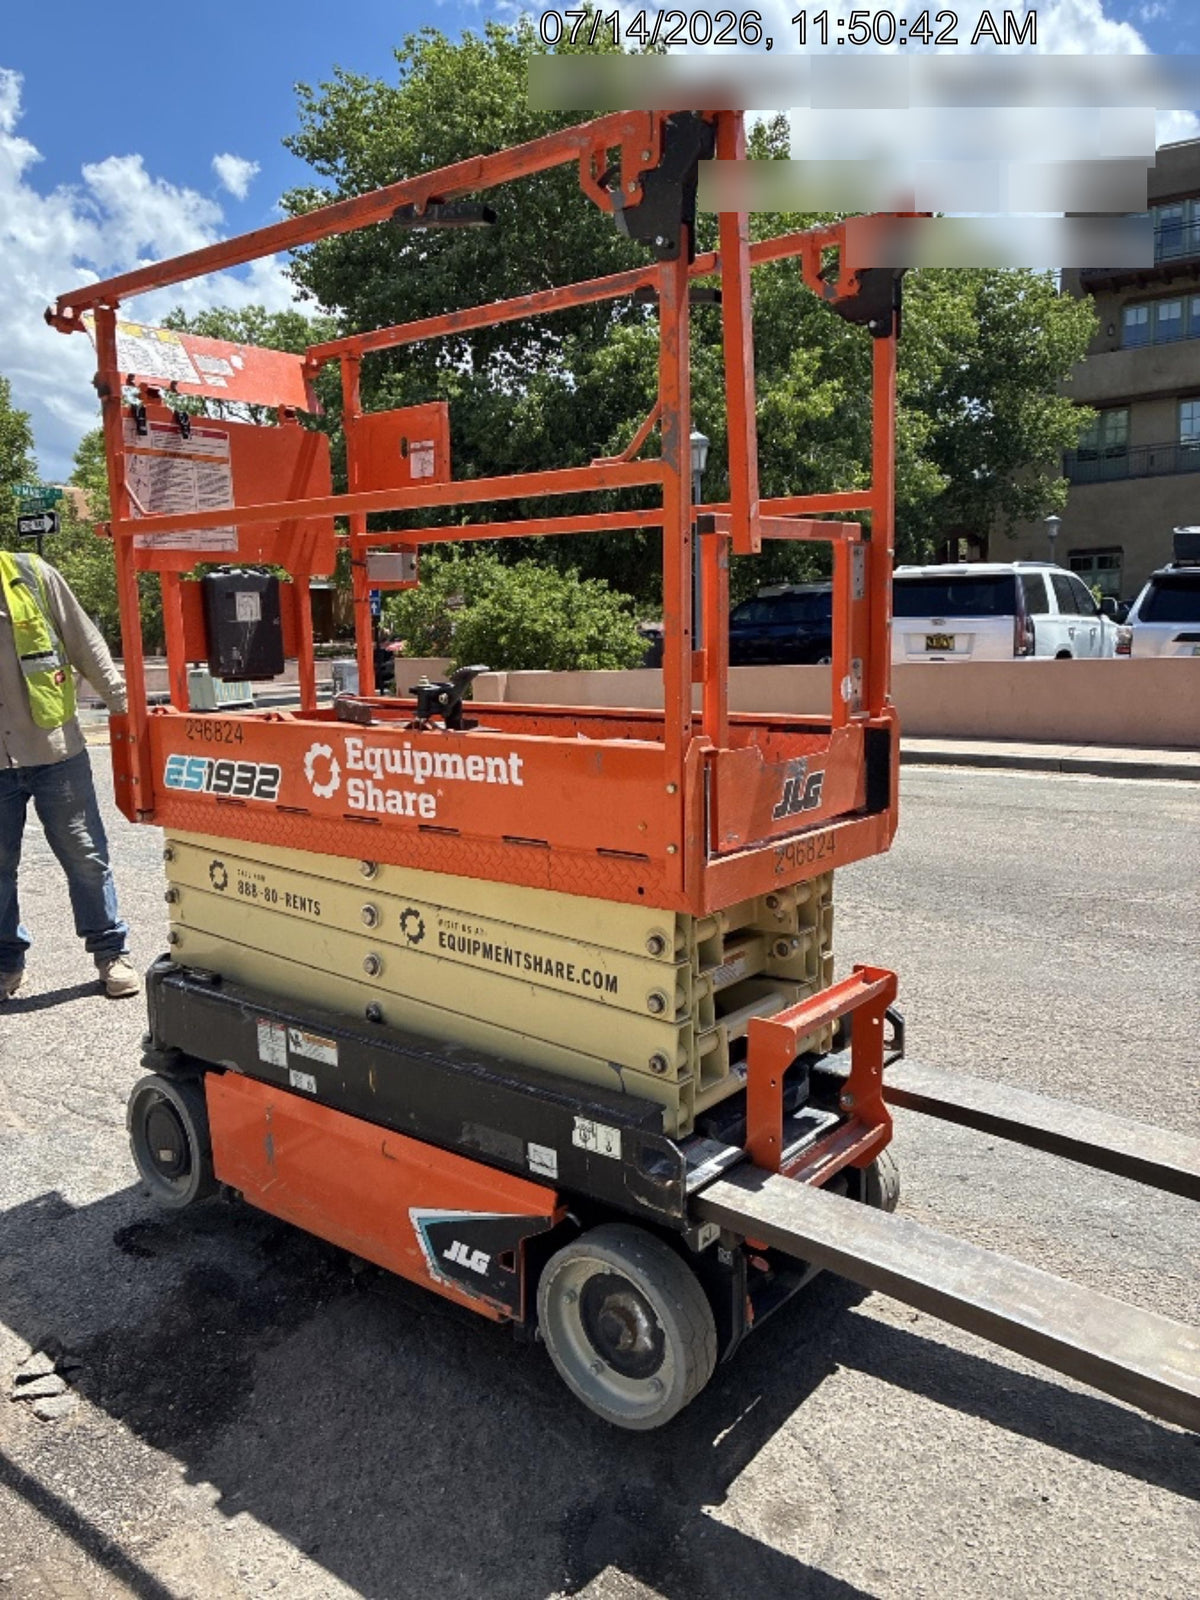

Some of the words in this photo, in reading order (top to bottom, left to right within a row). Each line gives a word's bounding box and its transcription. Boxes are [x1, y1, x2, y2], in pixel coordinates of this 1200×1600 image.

[186, 719, 244, 743] 296824
[164, 753, 281, 802] ES1932
[344, 737, 524, 786] Equipment
[347, 778, 437, 818] Share
[772, 769, 825, 821] JLG
[775, 830, 836, 873] 296824
[237, 880, 321, 916] 888-80-RENTS
[438, 931, 618, 993] EQUIPMENTSHARE.COM
[442, 1240, 491, 1275] JLG
